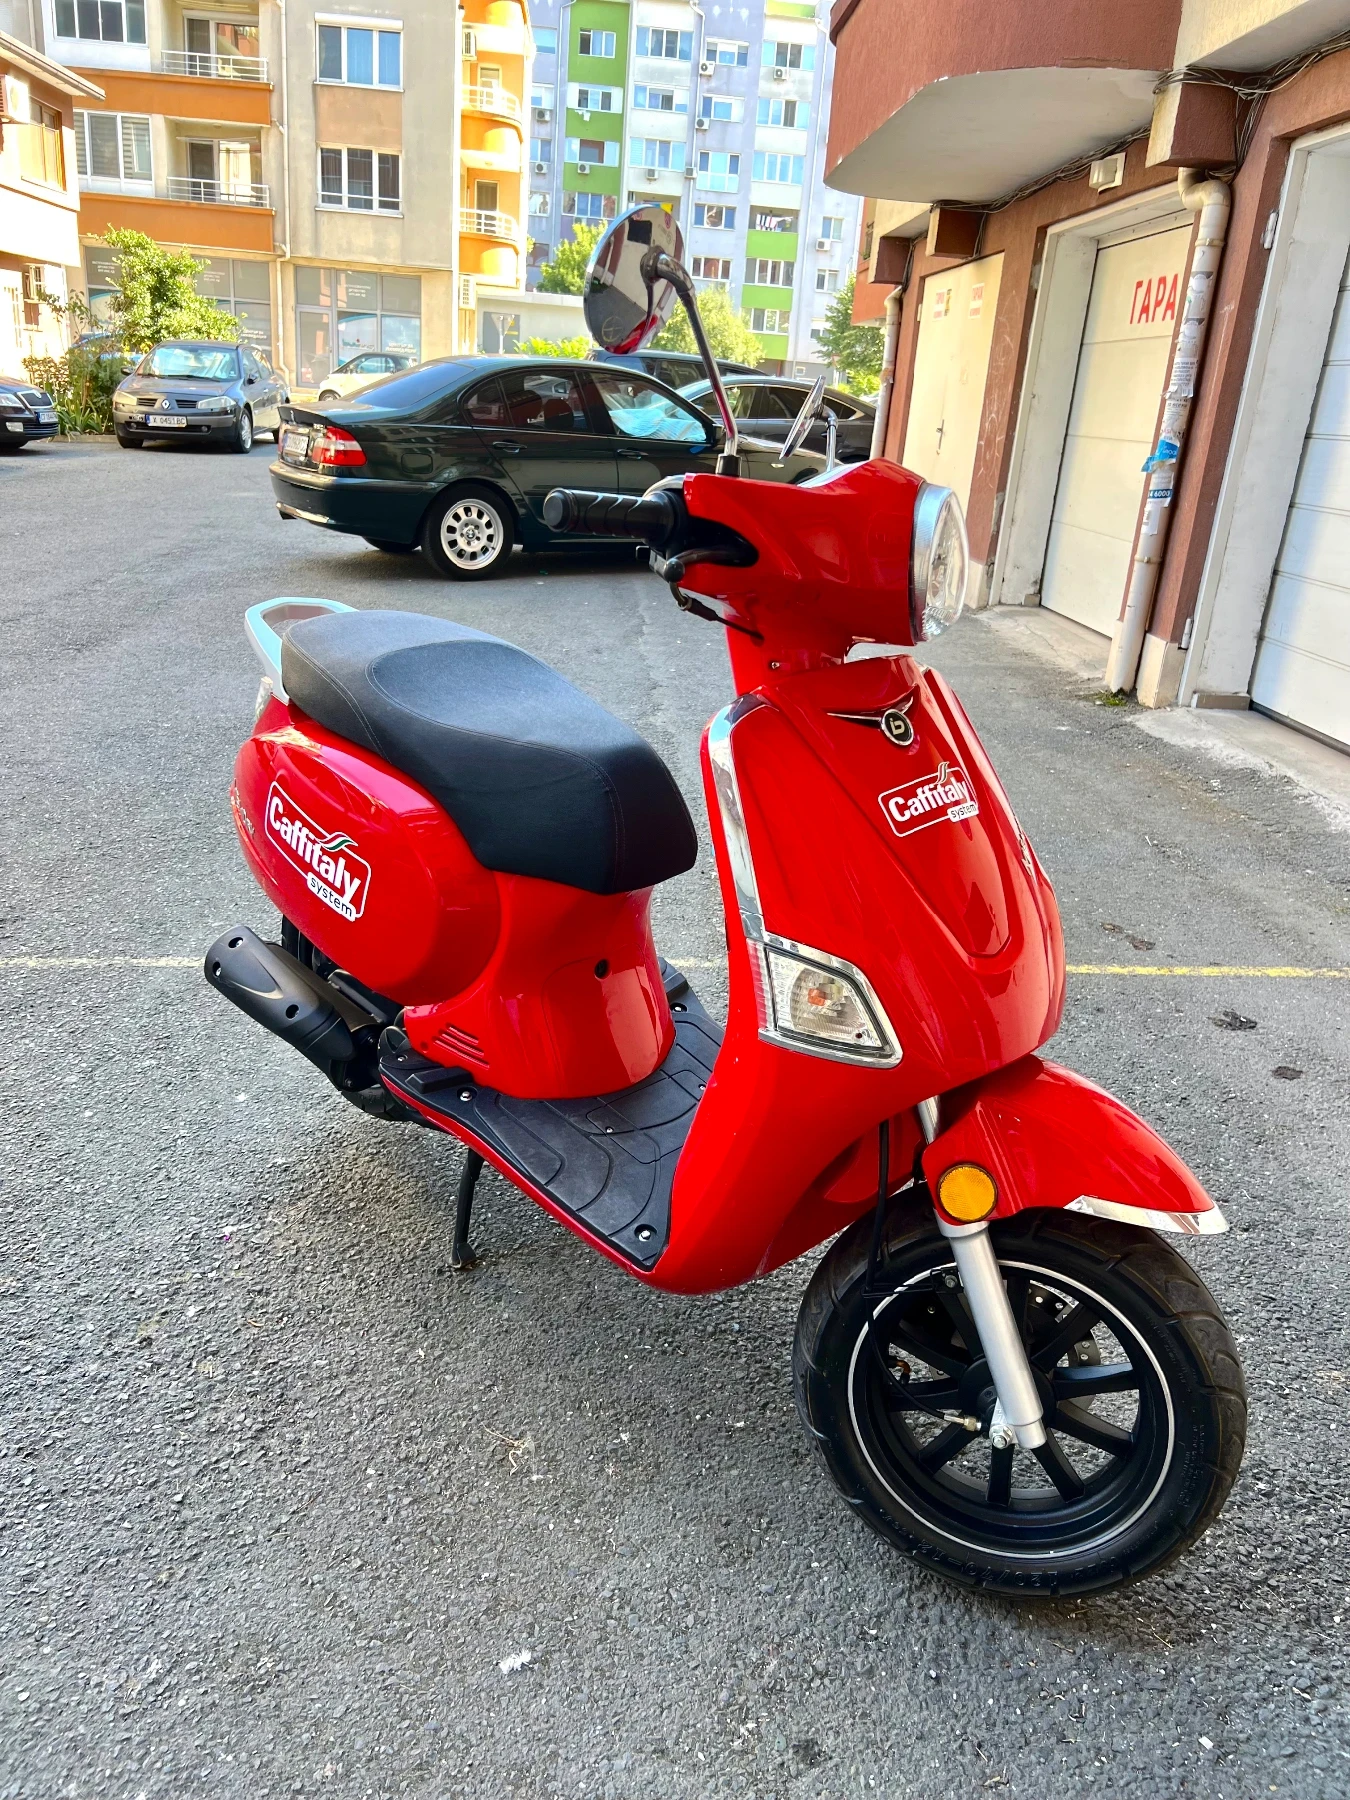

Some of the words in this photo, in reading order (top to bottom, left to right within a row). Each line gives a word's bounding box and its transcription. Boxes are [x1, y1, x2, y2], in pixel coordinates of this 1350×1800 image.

[888, 777, 970, 823] Caffitaly
[950, 803, 976, 819] system
[269, 796, 361, 903] Caffitaly
[310, 877, 353, 918] system
